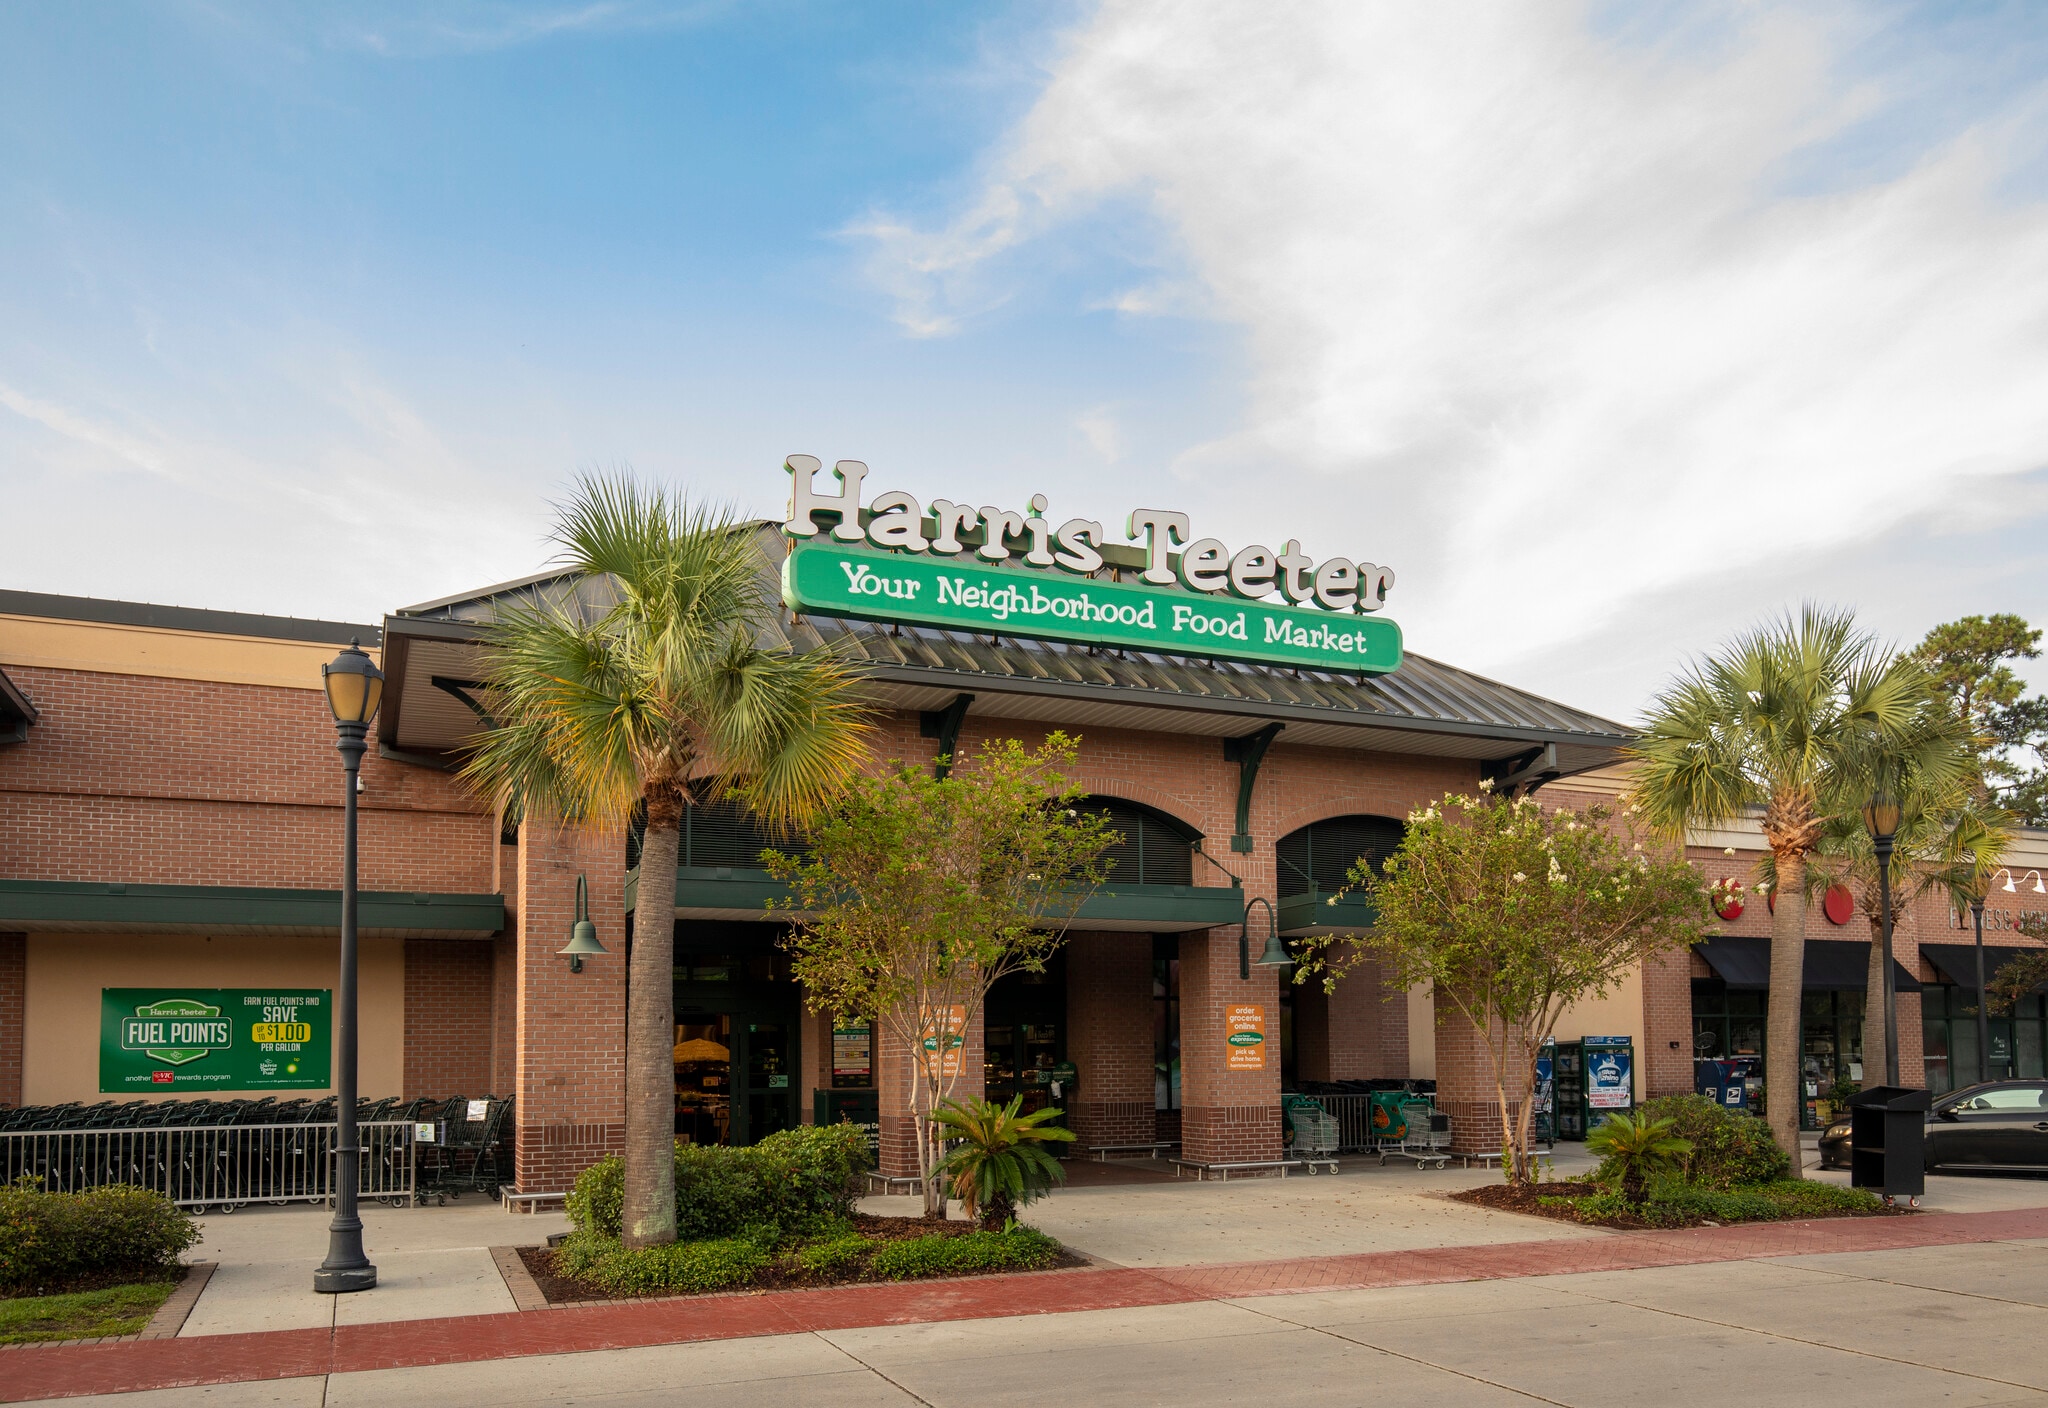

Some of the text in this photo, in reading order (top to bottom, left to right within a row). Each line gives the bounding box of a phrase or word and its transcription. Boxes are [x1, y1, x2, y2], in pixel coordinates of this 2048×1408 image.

[782, 454, 1395, 612] Harris Teeter
[839, 561, 1367, 654] Your Neighborhood Food Market
[244, 996, 320, 1006] EARN FUEL POINTS AND
[150, 1008, 207, 1016] Harris Teeter
[262, 1006, 298, 1023] SAVE
[1235, 1006, 1255, 1014] order
[1229, 1014, 1262, 1023] groceries
[256, 1025, 265, 1033] UP
[1234, 1022, 1257, 1030] online.
[128, 1022, 228, 1044] FUEL POINTS
[258, 1033, 266, 1041] TO
[267, 1024, 305, 1041] $1.00
[261, 1043, 301, 1052] PER GALLON
[1235, 1048, 1247, 1056] pick
[202, 1074, 231, 1082] program
